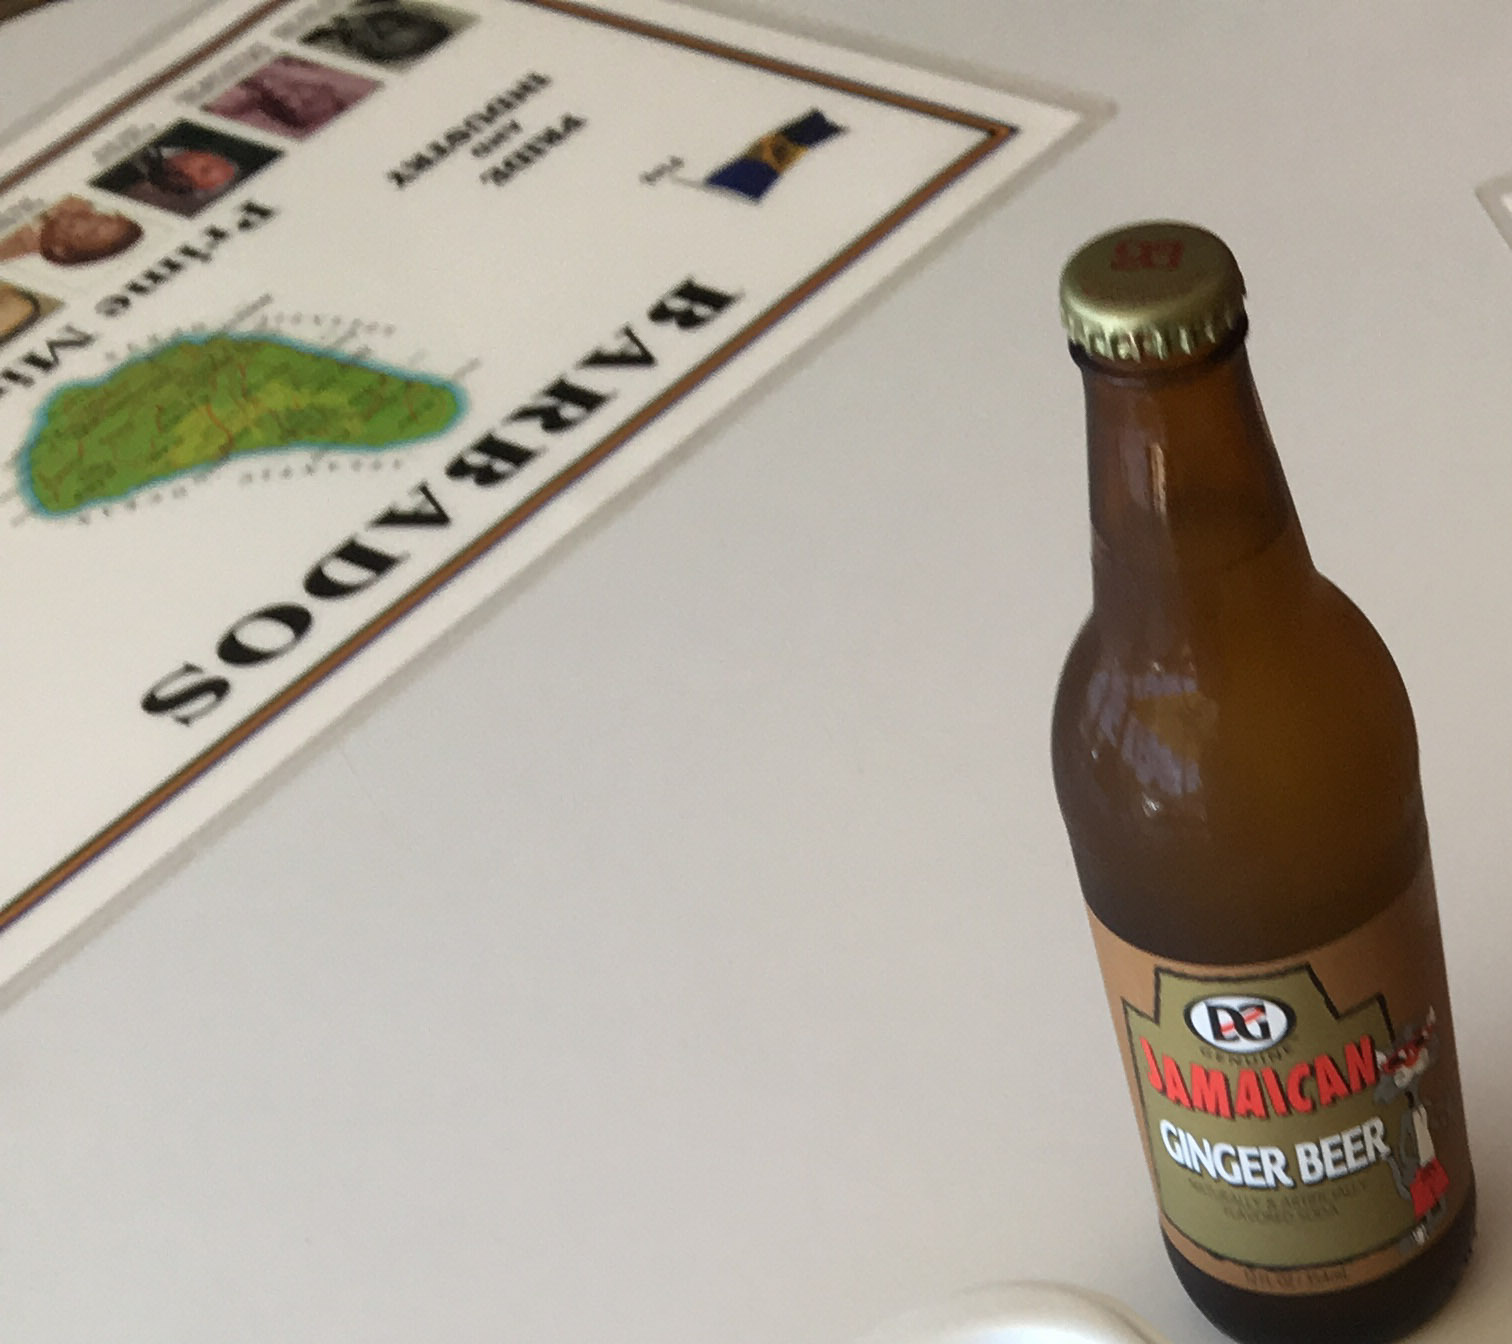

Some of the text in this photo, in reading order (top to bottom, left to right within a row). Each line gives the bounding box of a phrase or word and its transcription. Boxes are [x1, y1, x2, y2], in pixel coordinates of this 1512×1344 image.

[95, 198, 277, 319] Prime
[140, 276, 745, 727] BARBADOS
[1140, 1034, 1380, 1121] JAMAICAN
[1159, 1115, 1391, 1190] GINGER BEER
